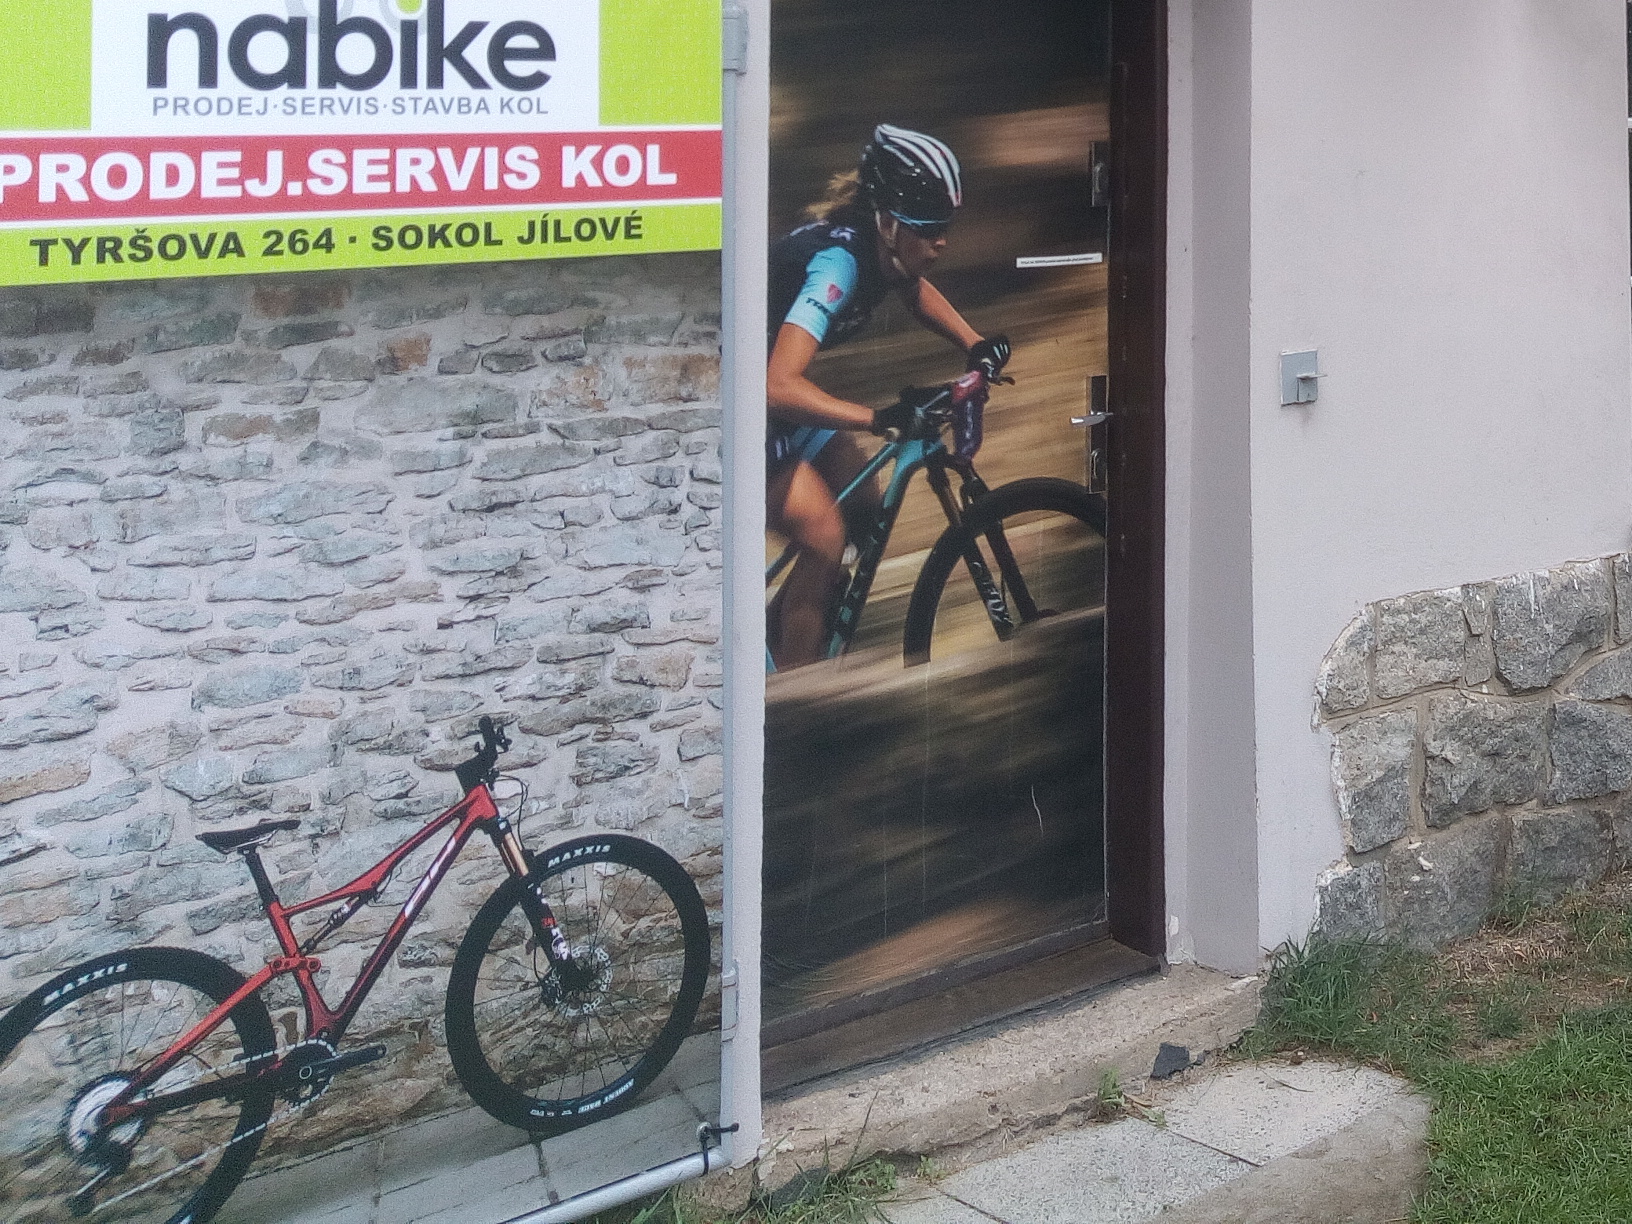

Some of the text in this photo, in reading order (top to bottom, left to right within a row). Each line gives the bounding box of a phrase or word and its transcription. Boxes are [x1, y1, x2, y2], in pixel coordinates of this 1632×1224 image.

[499, 96, 549, 116] KOL
[561, 143, 678, 189] KOL
[29, 210, 644, 267] TYRŠOVA 264 SOKOL JÍLOVÉ
[547, 844, 611, 868] MAXXIS
[43, 963, 128, 1005] MAXXIS
